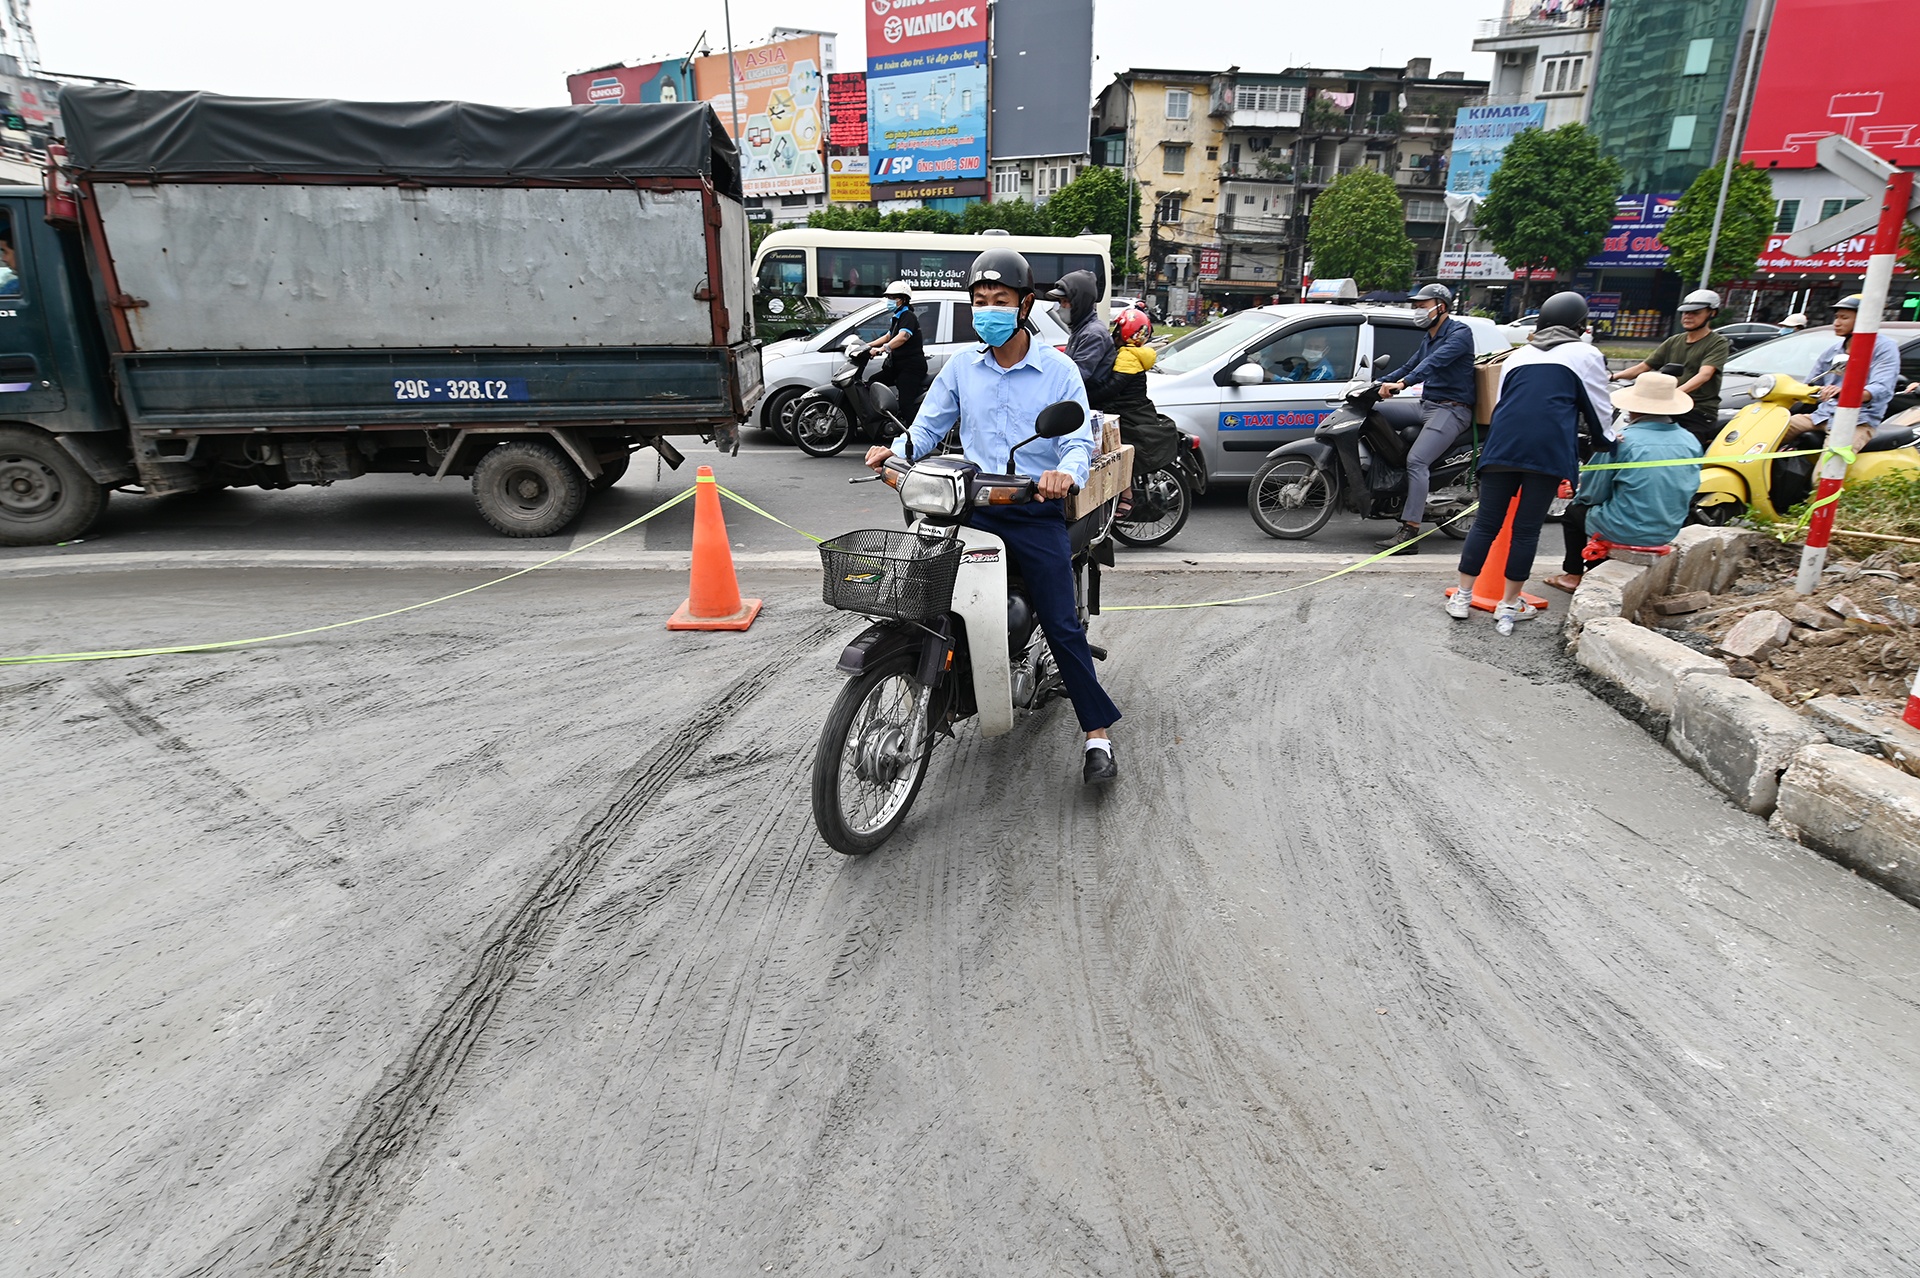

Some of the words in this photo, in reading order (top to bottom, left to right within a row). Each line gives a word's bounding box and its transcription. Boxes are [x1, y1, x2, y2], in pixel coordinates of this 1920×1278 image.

[903, 6, 978, 37] VANLOCK
[745, 47, 786, 68] ASIA
[900, 58, 912, 68] cho
[950, 51, 962, 61] cho
[963, 49, 978, 60] bạn
[747, 65, 785, 79] LIGHTING
[1469, 106, 1530, 120] KIMATA
[892, 156, 913, 174] SP
[917, 157, 933, 173] ỐNG
[935, 159, 957, 171] NƯỚC
[959, 156, 980, 169] SINO
[920, 187, 955, 196] COFFEE
[1793, 259, 1823, 268] THOẠI
[901, 269, 918, 277] Nhà
[920, 269, 936, 279] bạn
[944, 269, 965, 278] đâu?
[920, 279, 932, 288] tôi
[394, 379, 430, 400] 29C
[1243, 415, 1274, 427] TAXI
[1276, 412, 1315, 425] SÔNG
[920, 527, 942, 535] HONDA
